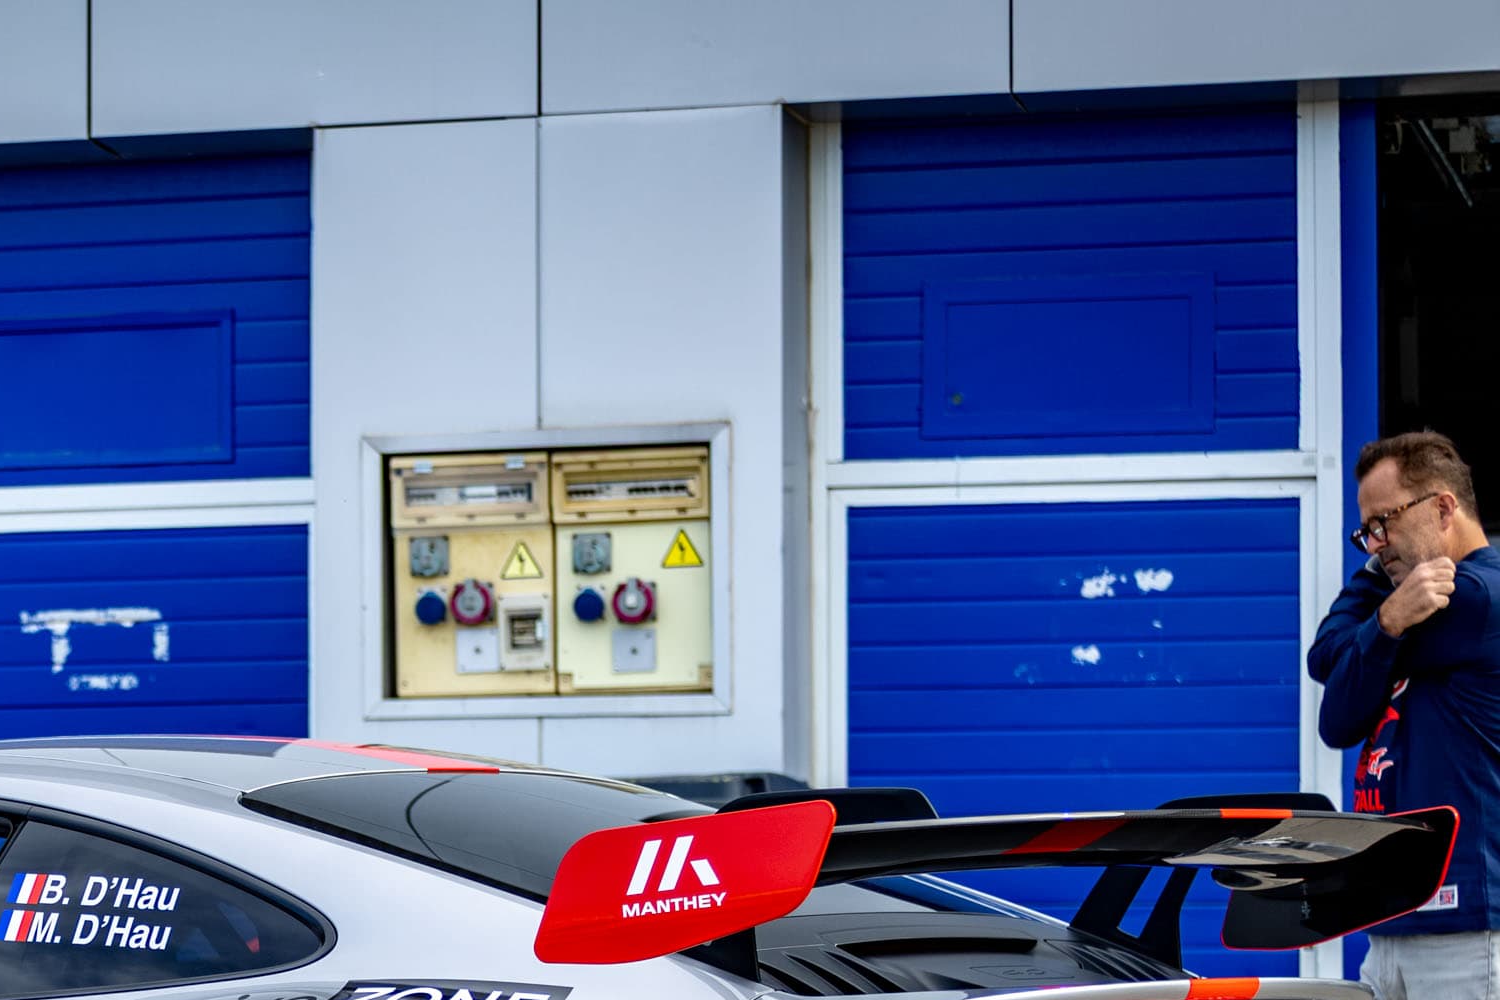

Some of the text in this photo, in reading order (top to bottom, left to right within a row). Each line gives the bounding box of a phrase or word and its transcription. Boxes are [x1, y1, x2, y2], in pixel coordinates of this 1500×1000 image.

[38, 874, 181, 911] B. D'Hau
[621, 891, 727, 918] MANTHEY
[26, 911, 172, 950] M. D'Hau
